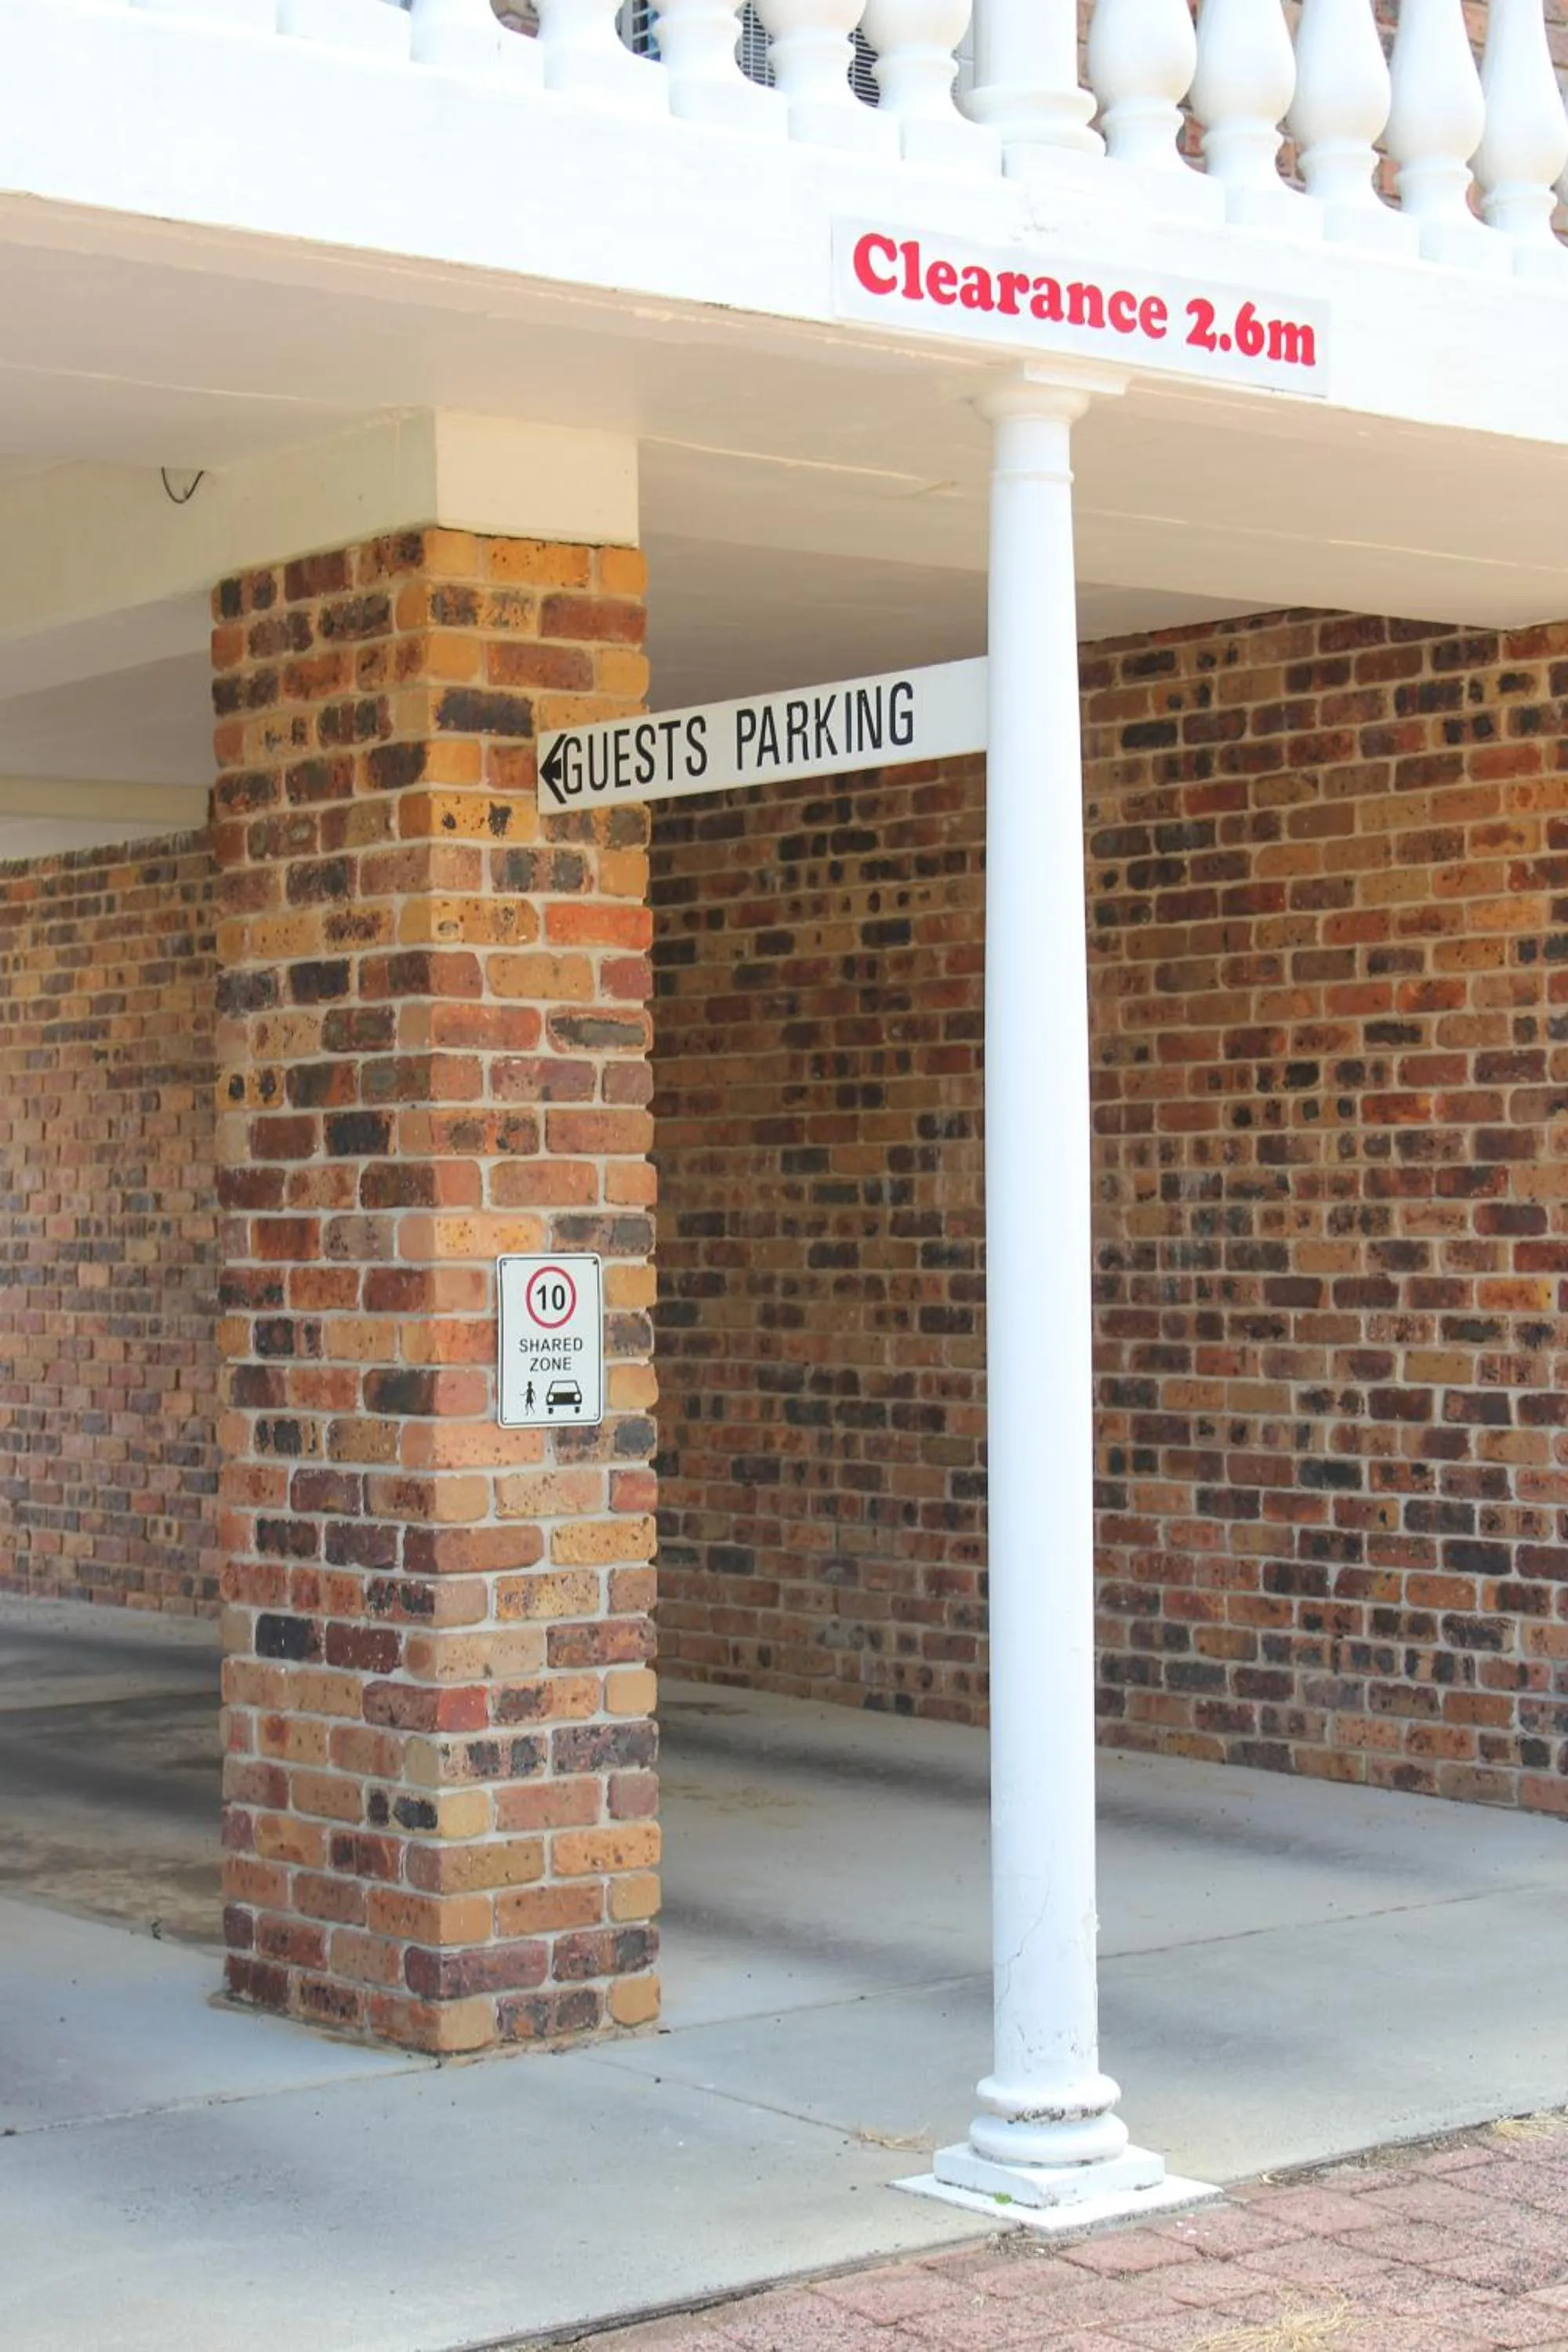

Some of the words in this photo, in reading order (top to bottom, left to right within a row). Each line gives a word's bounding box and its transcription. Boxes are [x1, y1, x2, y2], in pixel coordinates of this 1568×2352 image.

[853, 234, 1168, 339] Clearance
[1186, 299, 1316, 367] 2.6m
[561, 714, 708, 795] GUESTS
[735, 681, 914, 771] PARKING
[536, 1284, 566, 1311] 10
[519, 1337, 583, 1353] SHARED
[529, 1356, 572, 1372] ZONE
